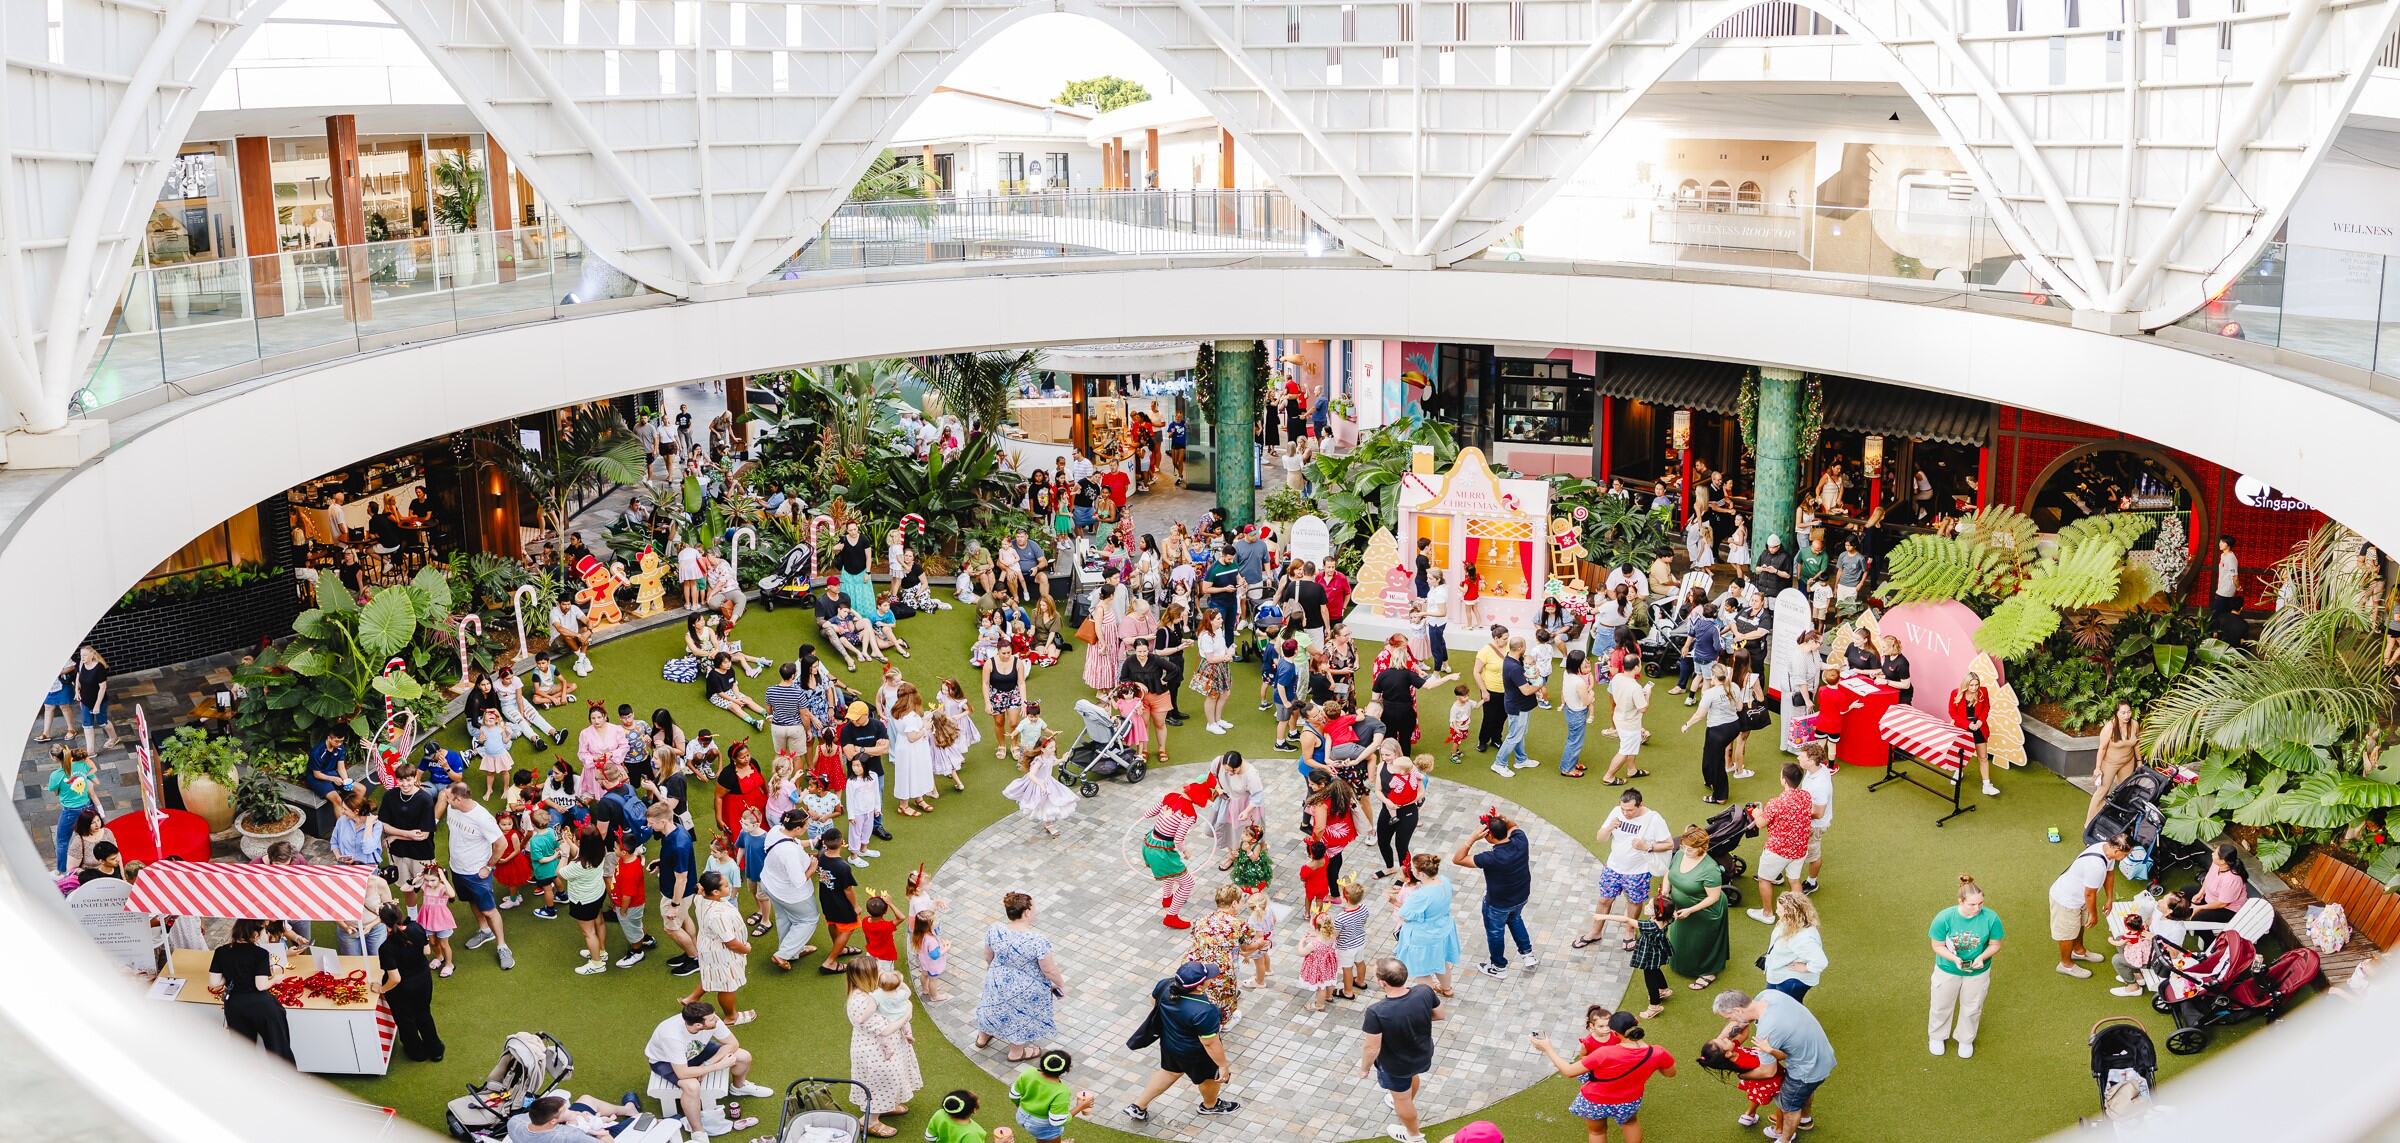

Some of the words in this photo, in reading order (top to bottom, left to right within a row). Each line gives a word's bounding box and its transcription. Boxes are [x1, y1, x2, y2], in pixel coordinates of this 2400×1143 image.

[2333, 221, 2393, 236] WELLNESS
[1456, 490, 1488, 500] MERRY
[1443, 499, 1498, 511] CHRISTMAS
[1904, 621, 1952, 657] WIN
